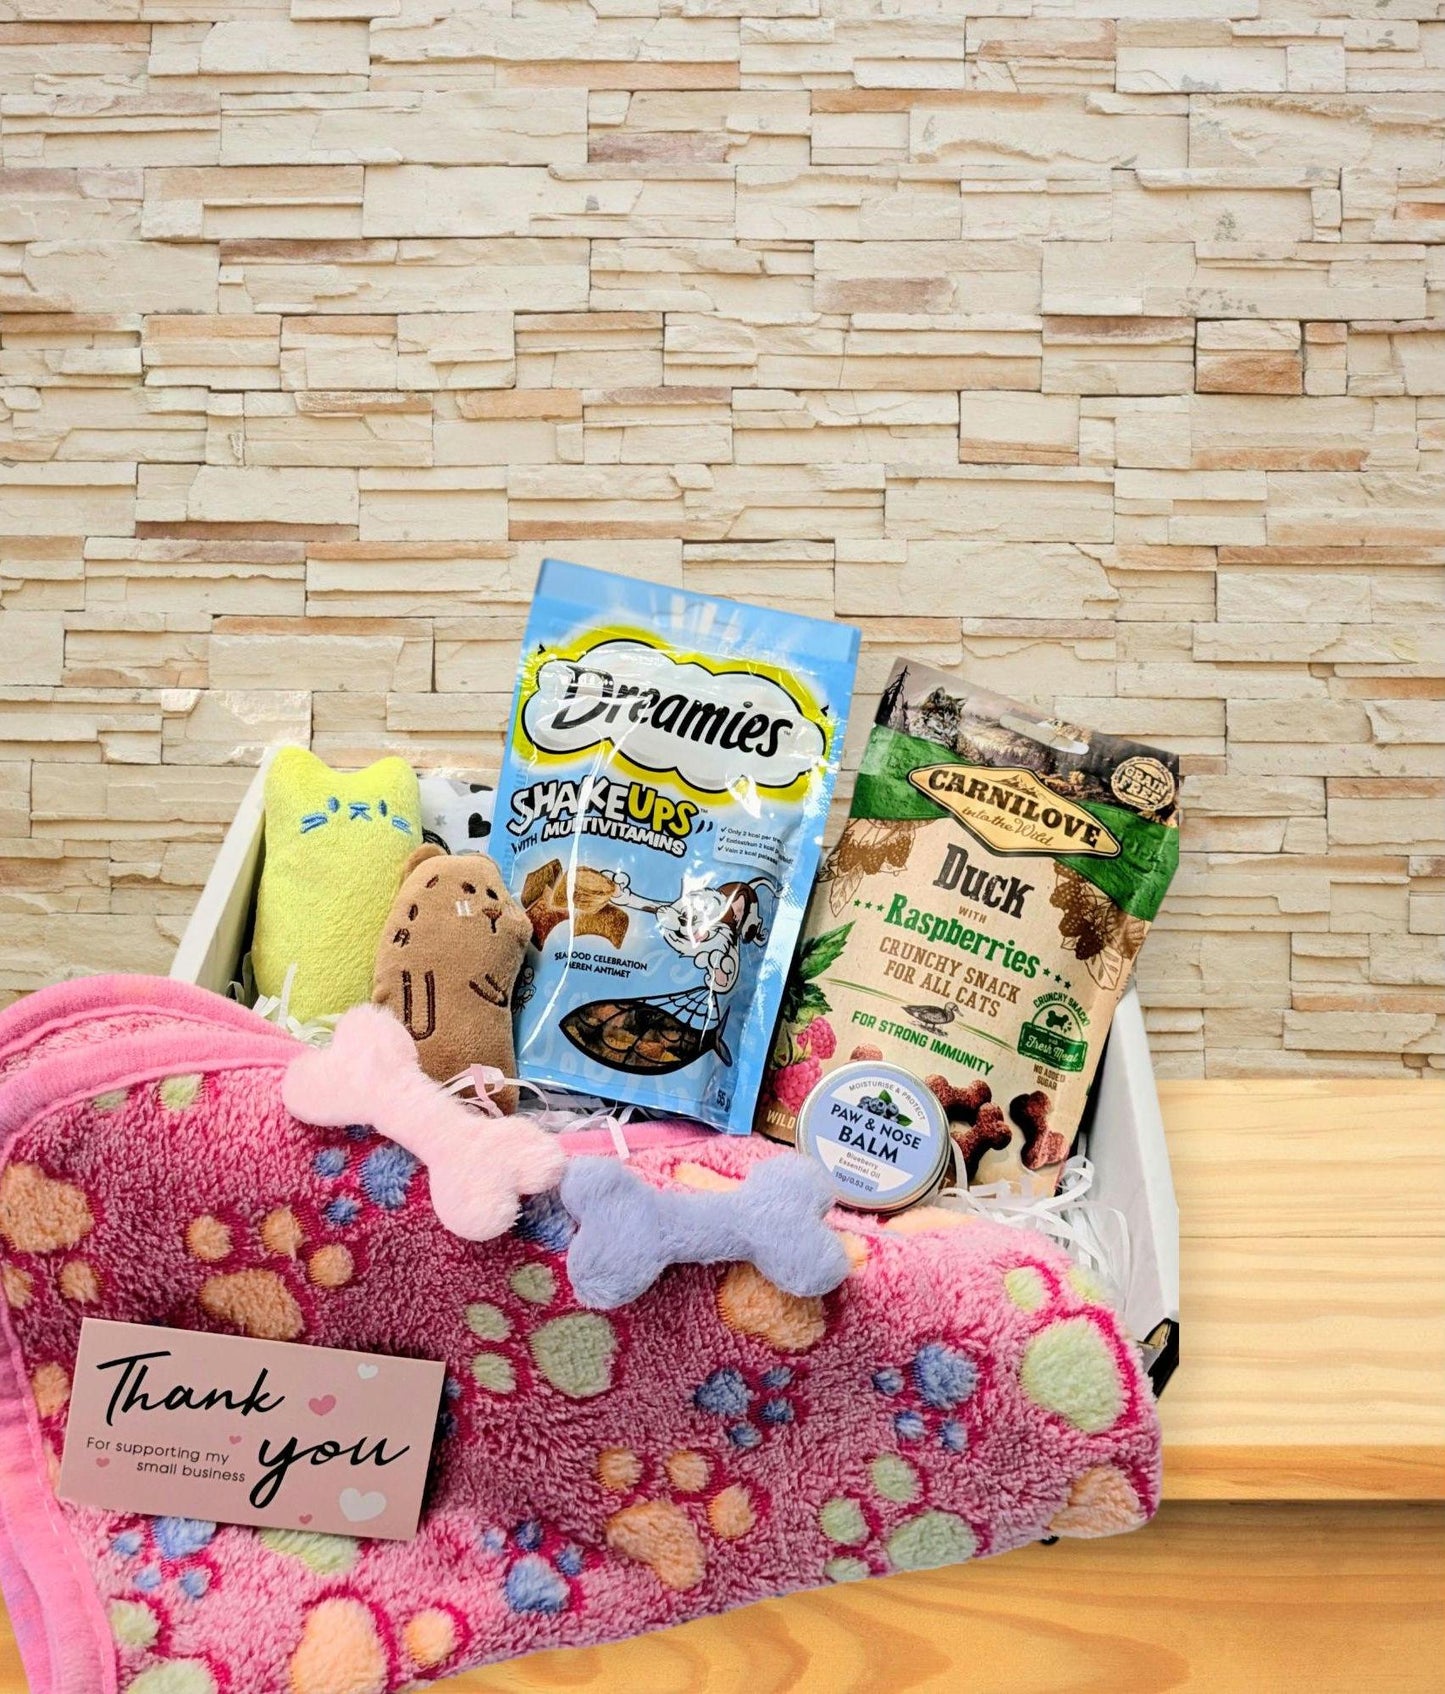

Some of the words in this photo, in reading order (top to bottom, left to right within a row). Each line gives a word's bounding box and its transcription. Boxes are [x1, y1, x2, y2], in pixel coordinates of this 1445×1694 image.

[552, 666, 794, 757] Dreamies
[1119, 774, 1162, 804] FREE
[1124, 765, 1168, 796] GRAIN
[928, 769, 1101, 848] CARNILOVE
[511, 833, 538, 854] WITH
[1014, 820, 1051, 847] Wild
[958, 906, 987, 924] WITH
[884, 893, 1040, 980] Raspberries
[554, 951, 591, 961] SEAOOD
[593, 954, 648, 971] CELEBRATION
[593, 966, 631, 978] ANTIMET
[879, 936, 963, 978] CRUNCHY
[963, 967, 1021, 1004] SNACK
[883, 959, 918, 985] FOR
[919, 971, 952, 999] ALL
[955, 984, 1001, 1018] CATS
[1033, 992, 1068, 1008] CRUNCHY
[851, 1010, 877, 1031] FOR
[878, 1016, 927, 1050] STRONG
[929, 1037, 995, 1076] IMMUNITY
[1025, 1035, 1052, 1055] Fresh
[1054, 1046, 1079, 1062] Meat
[1033, 1064, 1043, 1075] NO
[1036, 1075, 1058, 1090] SUGAR
[849, 1081, 894, 1091] MOISTURISE
[901, 1091, 926, 1120] PROTECT
[766, 1109, 797, 1129] WILD
[831, 1104, 863, 1124] PAW
[865, 1118, 875, 1132] &
[880, 1123, 922, 1150] NOSE
[838, 1125, 899, 1163] BALM
[839, 1157, 870, 1174] Essential
[871, 1170, 881, 1179] Oil
[847, 1152, 878, 1169] Blueberry
[835, 1170, 864, 1188] 15g/0.53
[864, 1184, 874, 1192] oz
[96, 1350, 286, 1426] Thank
[86, 1437, 111, 1450] For
[115, 1441, 200, 1463] supporting
[205, 1452, 230, 1466] my
[136, 1460, 177, 1476] small
[182, 1463, 246, 1483] business
[249, 1435, 411, 1509] you
